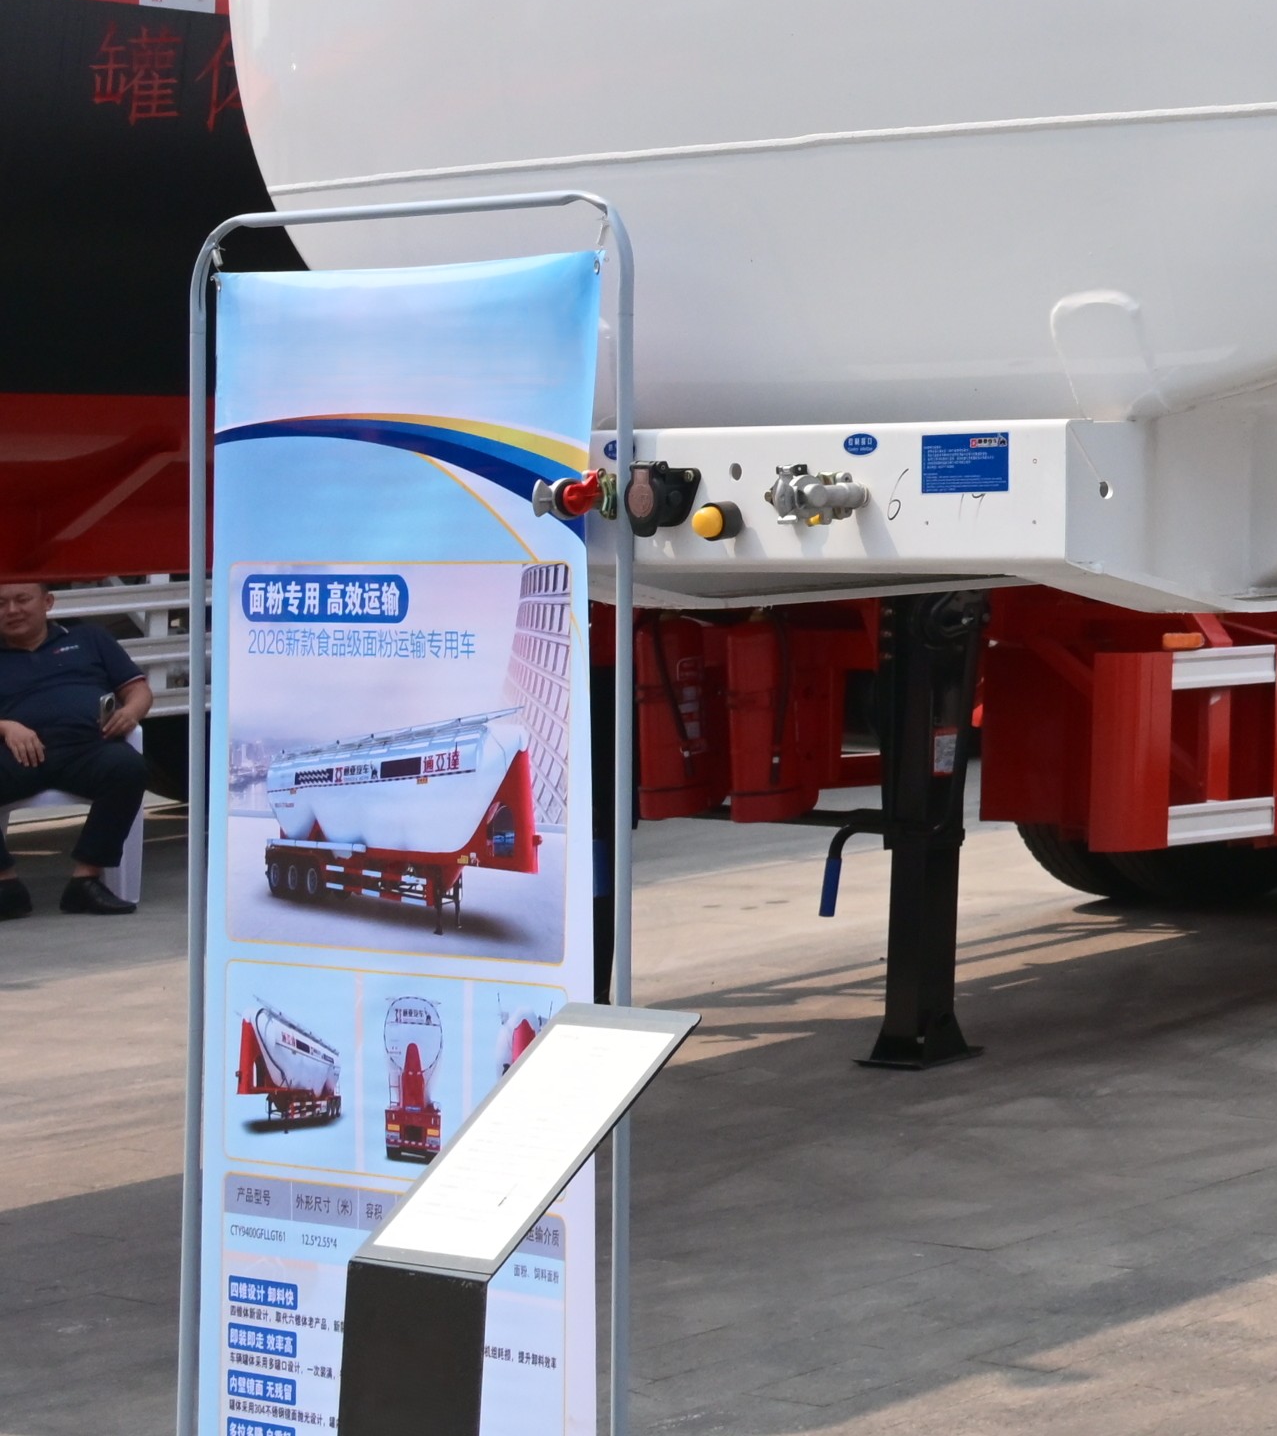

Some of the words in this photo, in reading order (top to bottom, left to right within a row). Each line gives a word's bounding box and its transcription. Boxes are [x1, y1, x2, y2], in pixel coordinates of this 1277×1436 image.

[248, 582, 320, 615] 面粉专用
[327, 581, 400, 617] 高效运输
[248, 628, 476, 660] 2026新款食品级面粉运输专用车
[236, 1187, 271, 1206] 产品型号
[365, 1203, 383, 1220] 容积
[513, 1264, 559, 1284] 面粉、饲料面粉
[230, 1281, 265, 1302] 四锥设计
[267, 1285, 294, 1306] 卸料快
[229, 1328, 264, 1349] 即装即走
[266, 1334, 293, 1353] 效率高
[229, 1375, 264, 1396] 内壁镜面
[265, 1381, 292, 1401] 无残留
